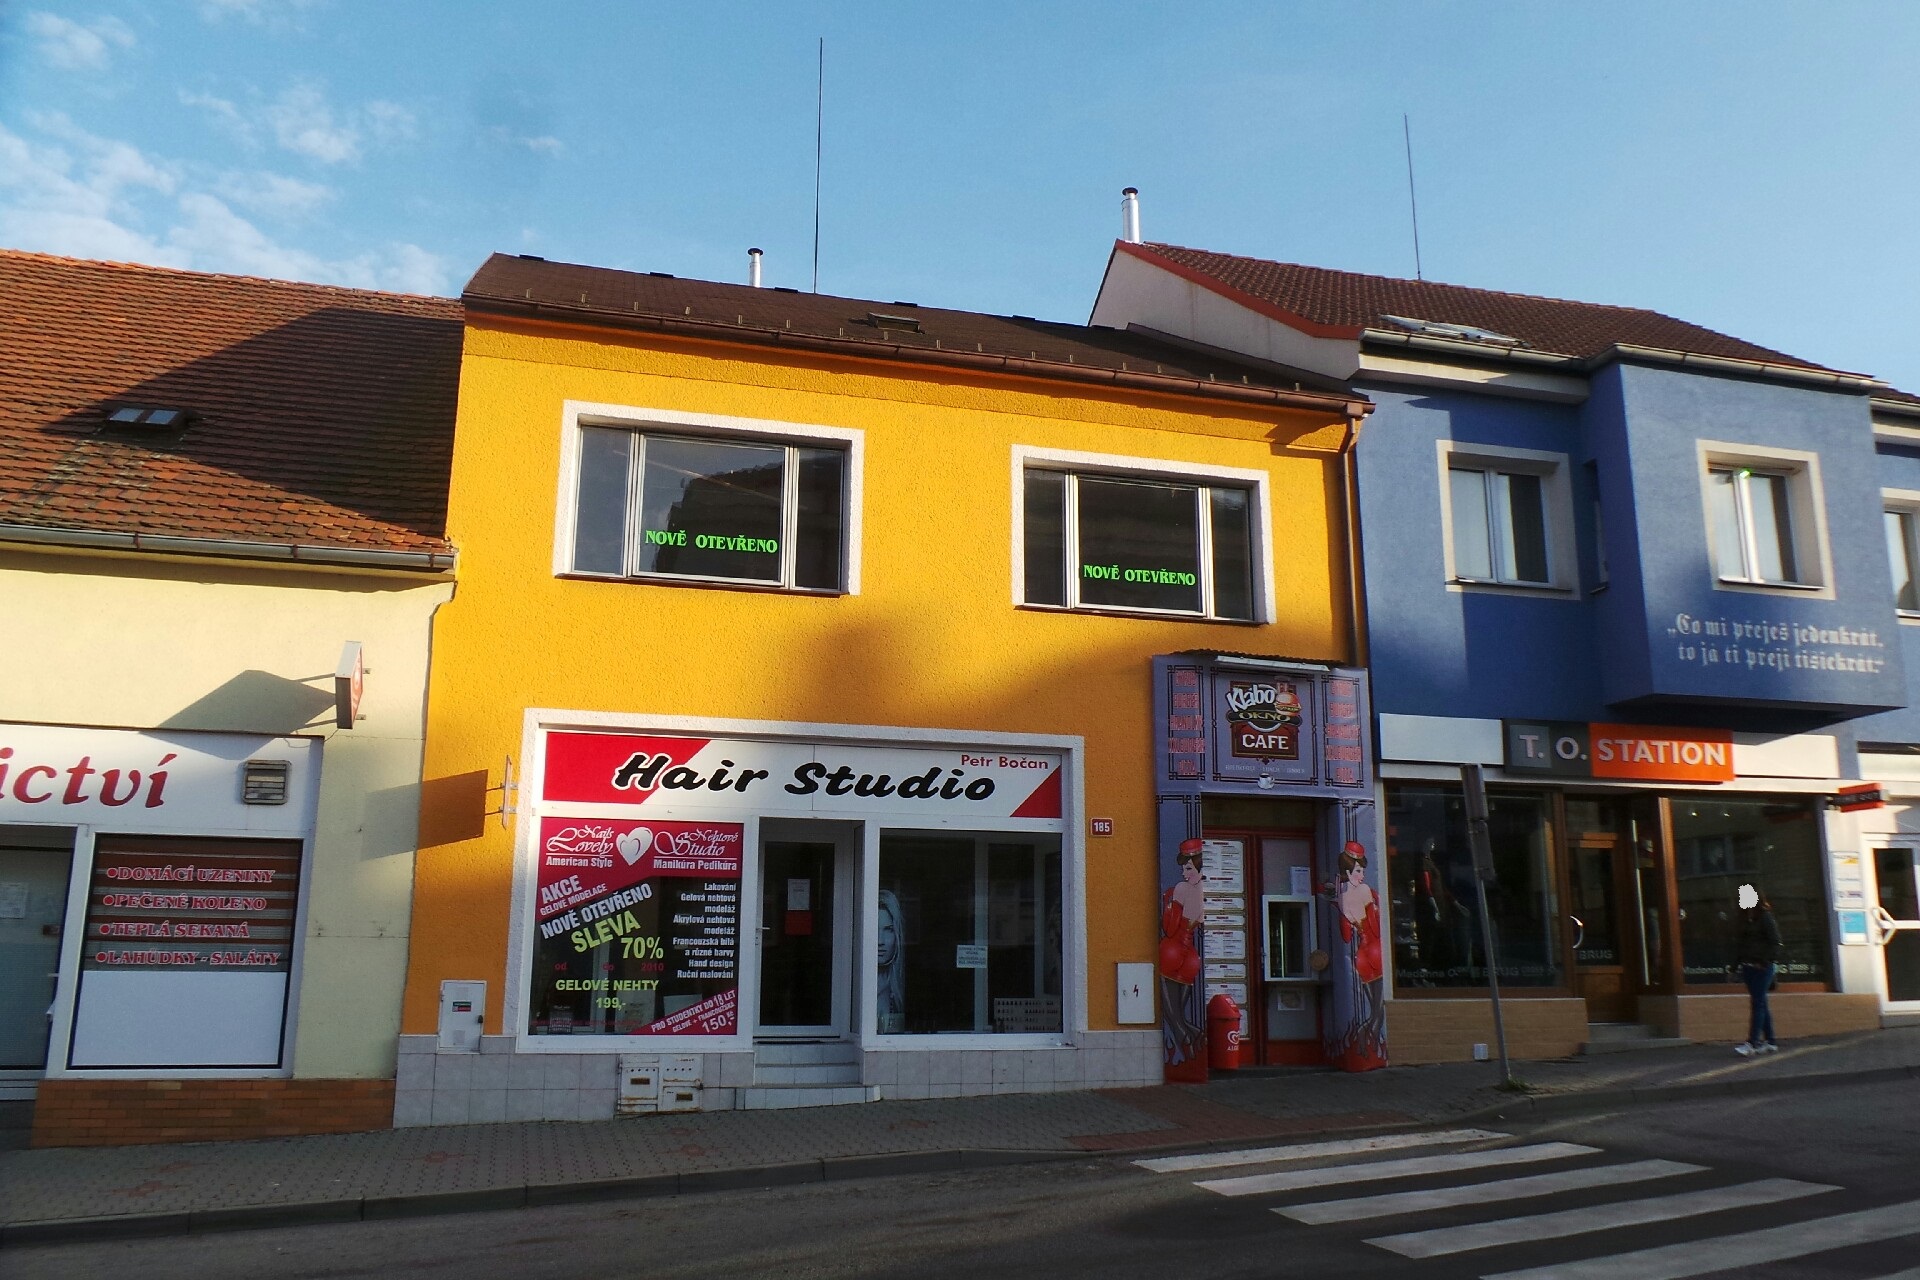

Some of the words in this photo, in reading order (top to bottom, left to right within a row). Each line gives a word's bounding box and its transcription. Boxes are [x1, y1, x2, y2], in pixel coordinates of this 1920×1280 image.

[645, 530, 688, 546] NOVĚ
[695, 535, 778, 553] OTEVŘENO
[1083, 564, 1120, 580] NOVĚ
[1124, 568, 1196, 586] OTEVŘENO
[1705, 617, 1727, 636] mi
[1679, 642, 1696, 660] to
[1238, 711, 1290, 721] OKNO
[1242, 734, 1289, 749] CAFE
[1519, 734, 1545, 759] T.
[1555, 736, 1588, 761] O.
[1596, 738, 1727, 766] STATION
[960, 754, 993, 768] Petr
[998, 755, 1050, 770] Bočan
[611, 752, 769, 793] Hair
[783, 760, 998, 801] Studio
[578, 825, 614, 838] Nails
[1093, 821, 1110, 832] 185
[546, 827, 613, 858] Lovely
[654, 831, 725, 856] Studio
[546, 856, 589, 867] American
[591, 857, 613, 868] Style
[653, 859, 695, 869] Manikúra
[697, 860, 737, 870] Pedikúra
[117, 865, 194, 881] DOMÁCÍ
[197, 869, 276, 883] UZENINY
[541, 874, 582, 904] AKCE
[567, 883, 608, 905] MODELACE
[113, 892, 188, 909] PEČENÉ
[191, 896, 268, 911] KOLENO
[540, 909, 580, 939] NOVĚ
[581, 883, 653, 922] OTEVŘENO
[113, 920, 171, 937] TEPLÁ
[174, 921, 250, 938] SEKANÁ
[571, 910, 641, 953] SLEVA
[620, 936, 664, 959] 70%
[210, 949, 281, 966] SALÁTY
[641, 962, 664, 971] 2010
[688, 959, 707, 967] Hand
[709, 959, 734, 968] design
[555, 977, 609, 991] GELOVÉ
[613, 980, 659, 991] NEHTY
[596, 997, 626, 1011] 199,-
[651, 1021, 666, 1033] PRO
[666, 1004, 703, 1026] STUDENTKY
[703, 1000, 714, 1009] DO
[724, 989, 736, 1000] LET
